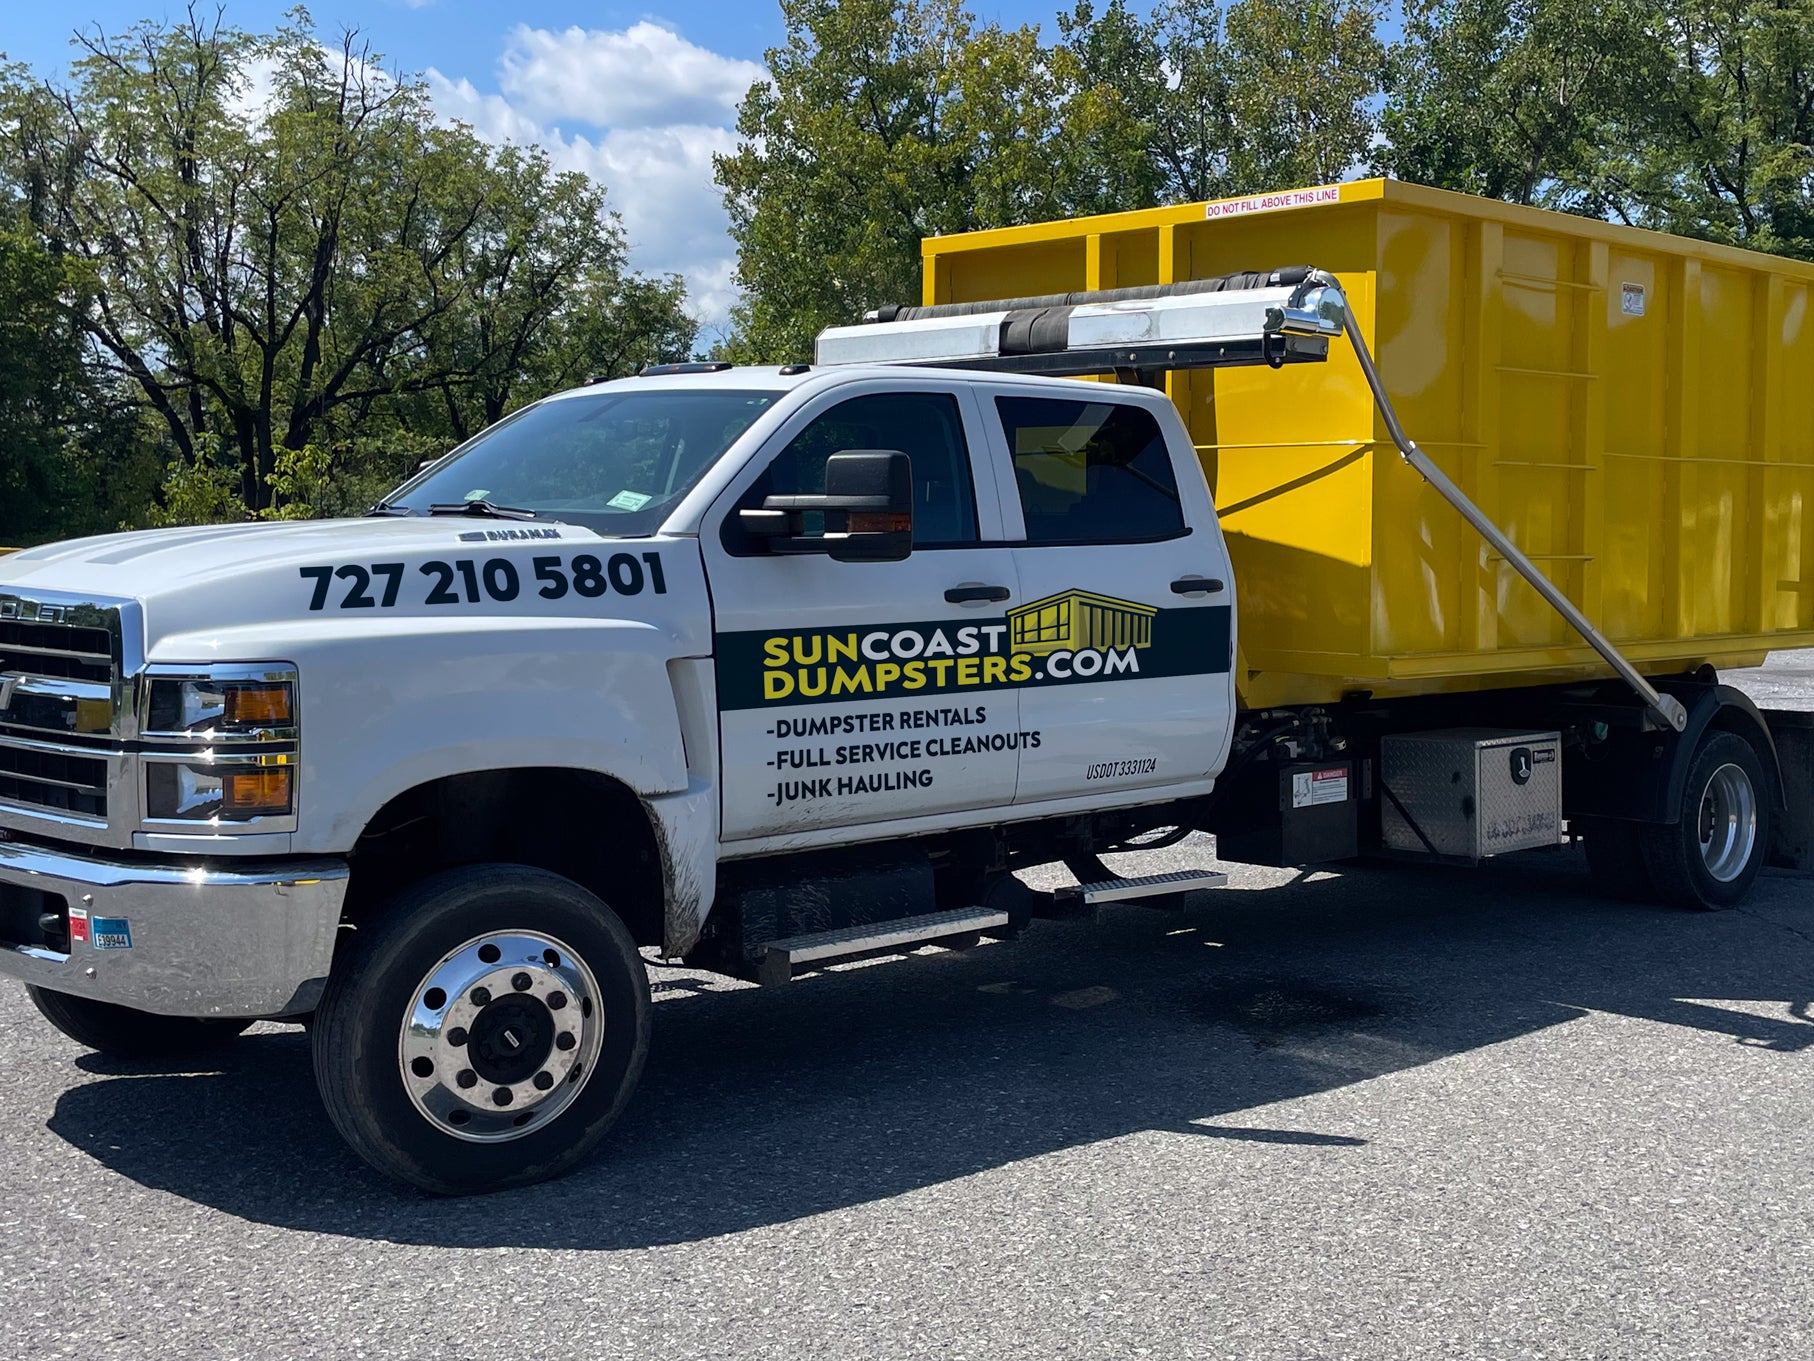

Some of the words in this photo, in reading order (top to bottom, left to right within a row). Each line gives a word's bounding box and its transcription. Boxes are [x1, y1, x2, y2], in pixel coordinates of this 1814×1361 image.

[1208, 205, 1220, 216] DO
[1222, 203, 1239, 214] NOT
[1241, 201, 1258, 212] FILL
[1261, 195, 1291, 208] ABOVE
[1294, 192, 1314, 204] THIS
[1316, 189, 1337, 201] LINE
[299, 562, 405, 611] 727
[418, 557, 521, 606] 210
[531, 551, 668, 601] 5801
[762, 624, 1007, 668] SUNCOAST
[763, 646, 1140, 700] DUMPSTERS.COM
[766, 712, 895, 739] -DUMPSTER
[899, 706, 987, 730] RENTALS
[766, 747, 832, 771] -FULL
[834, 740, 922, 766] SERVICE
[925, 730, 1042, 758] CLEANOUTS
[766, 775, 833, 808] -JUNK
[837, 768, 934, 797] HAULING
